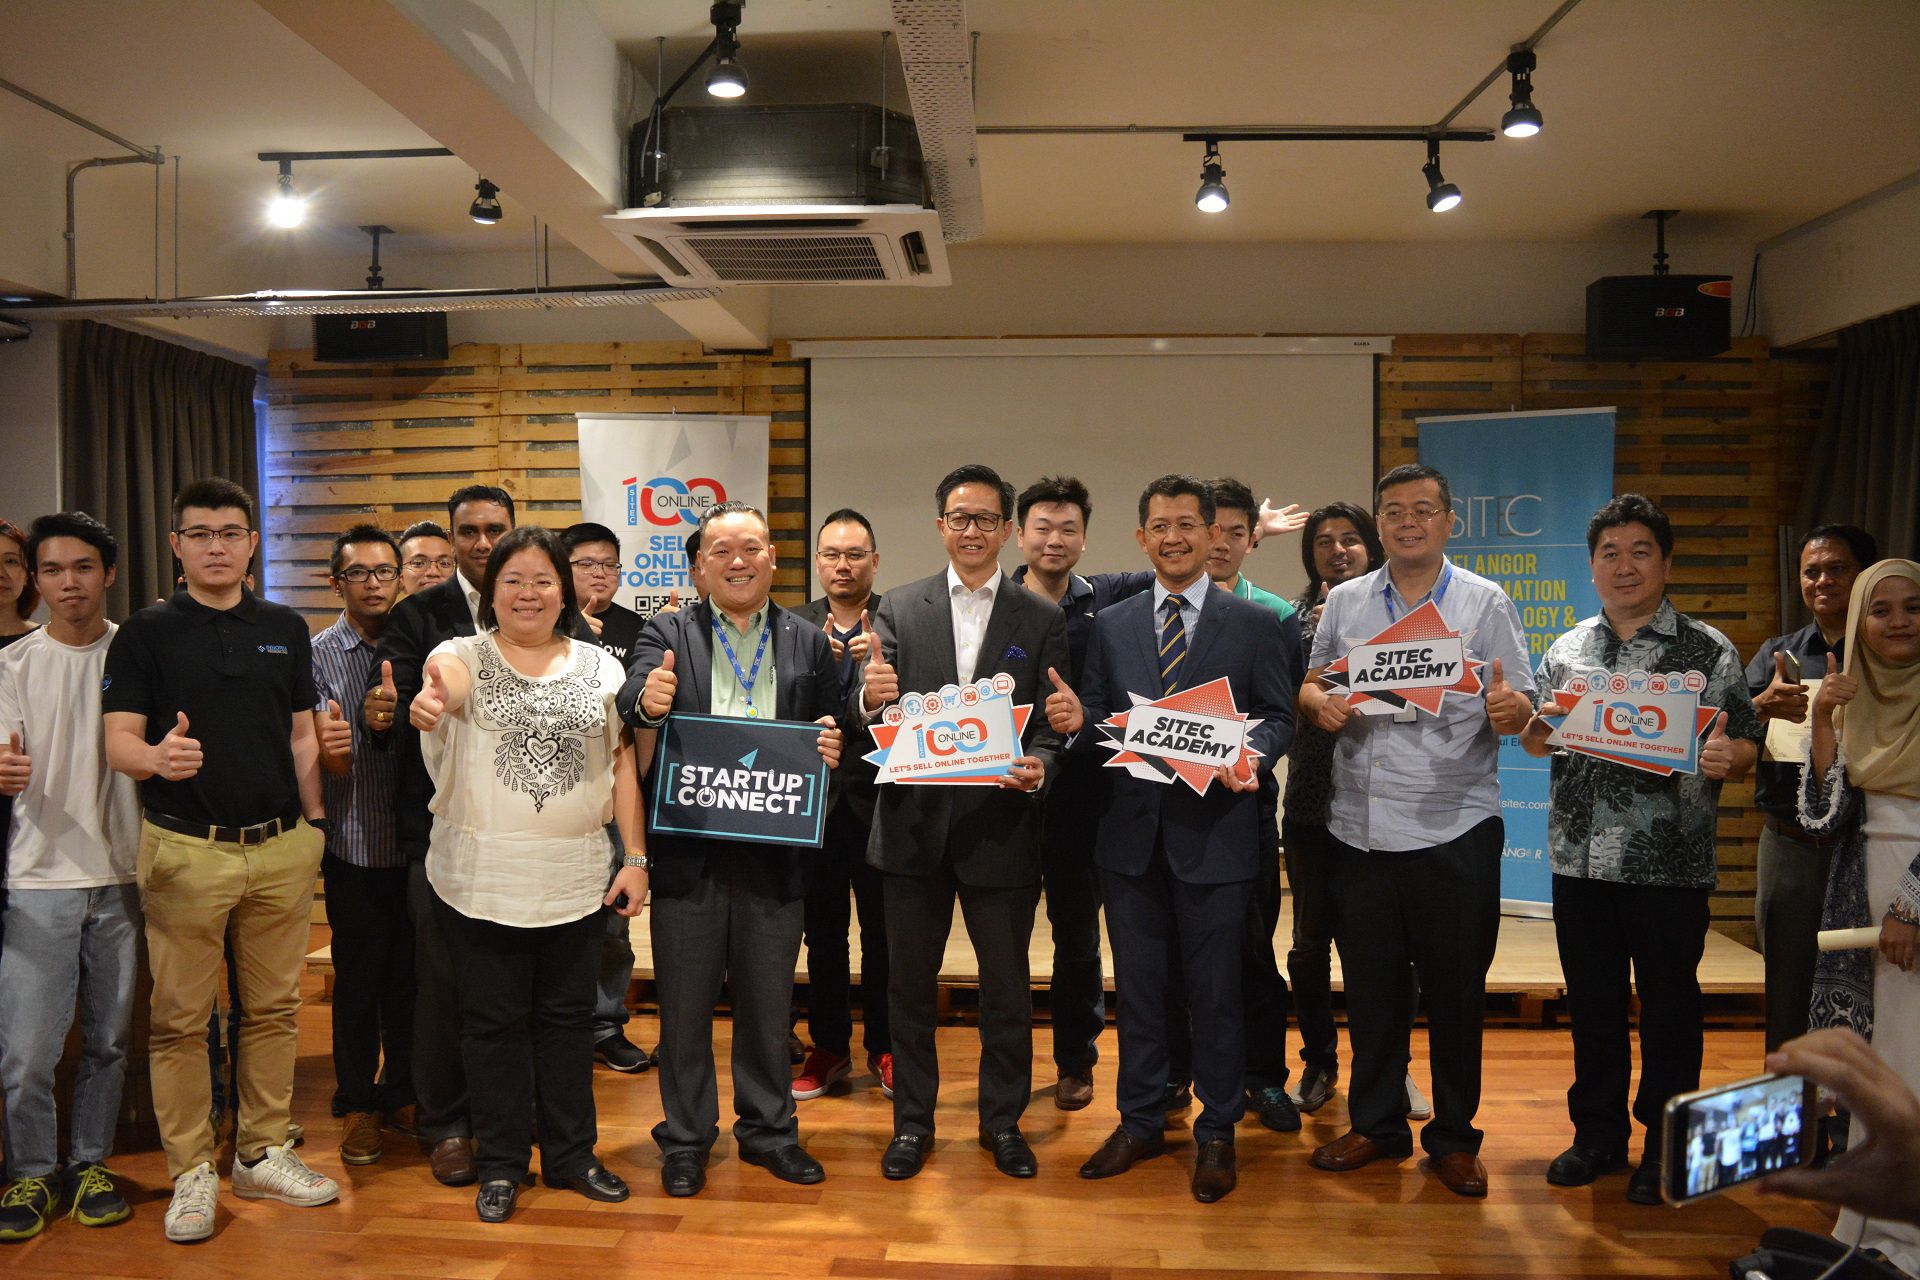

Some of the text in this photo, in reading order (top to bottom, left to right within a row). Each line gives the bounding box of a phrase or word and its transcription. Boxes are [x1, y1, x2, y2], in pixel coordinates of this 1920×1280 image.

[657, 495, 710, 508] ONLINE
[649, 535, 686, 552] SEL
[634, 553, 691, 570] ONLI
[1523, 605, 1576, 628] OGY &
[600, 641, 627, 658] OW
[1374, 648, 1434, 666] SITEC
[1354, 662, 1457, 684] ACADEMY
[1154, 716, 1215, 739] SITEC
[1615, 714, 1655, 727] ONLINE
[938, 730, 976, 743] ONLINE
[1129, 729, 1236, 759] ACADEMY
[1561, 732, 1685, 755] LET'S SELL ONLINE TOGETHER
[889, 753, 1011, 774] LET'S SELL ONLINE TOGETHER
[680, 764, 803, 793] STARTUP
[677, 786, 802, 815] CONNECT
